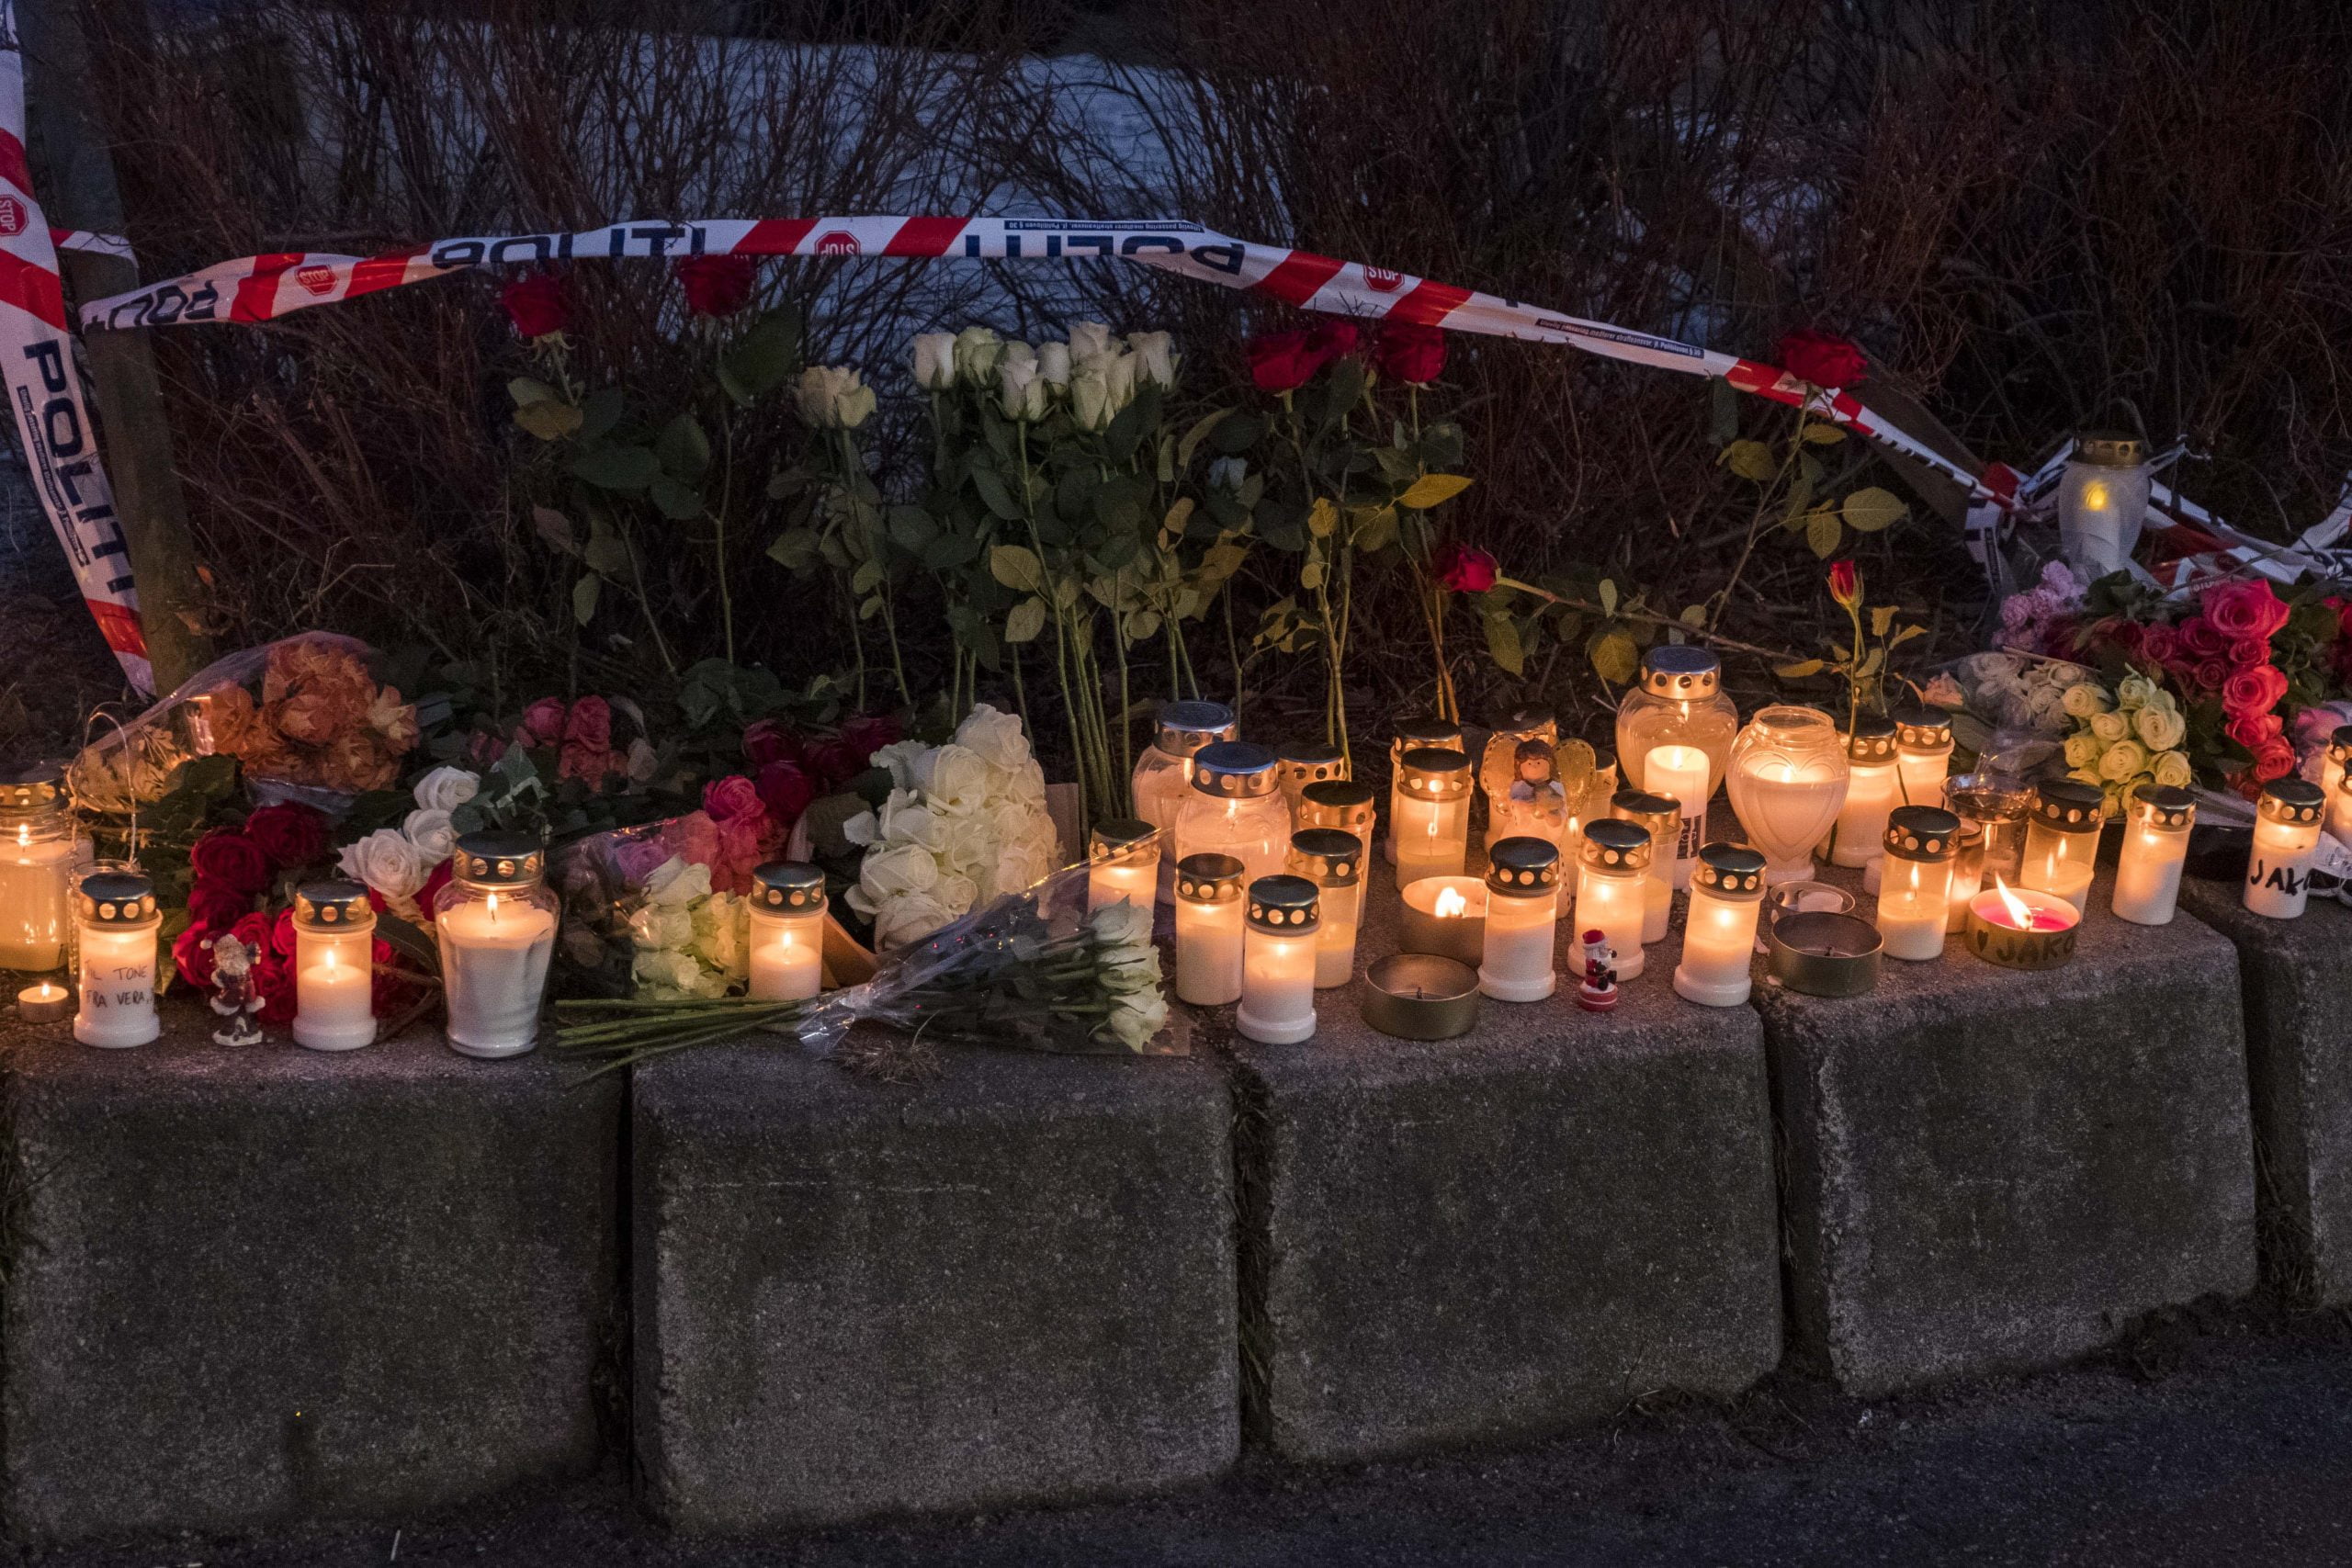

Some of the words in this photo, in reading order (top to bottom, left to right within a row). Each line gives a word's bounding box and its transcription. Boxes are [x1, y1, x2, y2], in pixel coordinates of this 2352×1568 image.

[0, 199, 16, 232] STOP
[23, 339, 135, 594] POLITI
[112, 963, 147, 981] TONE
